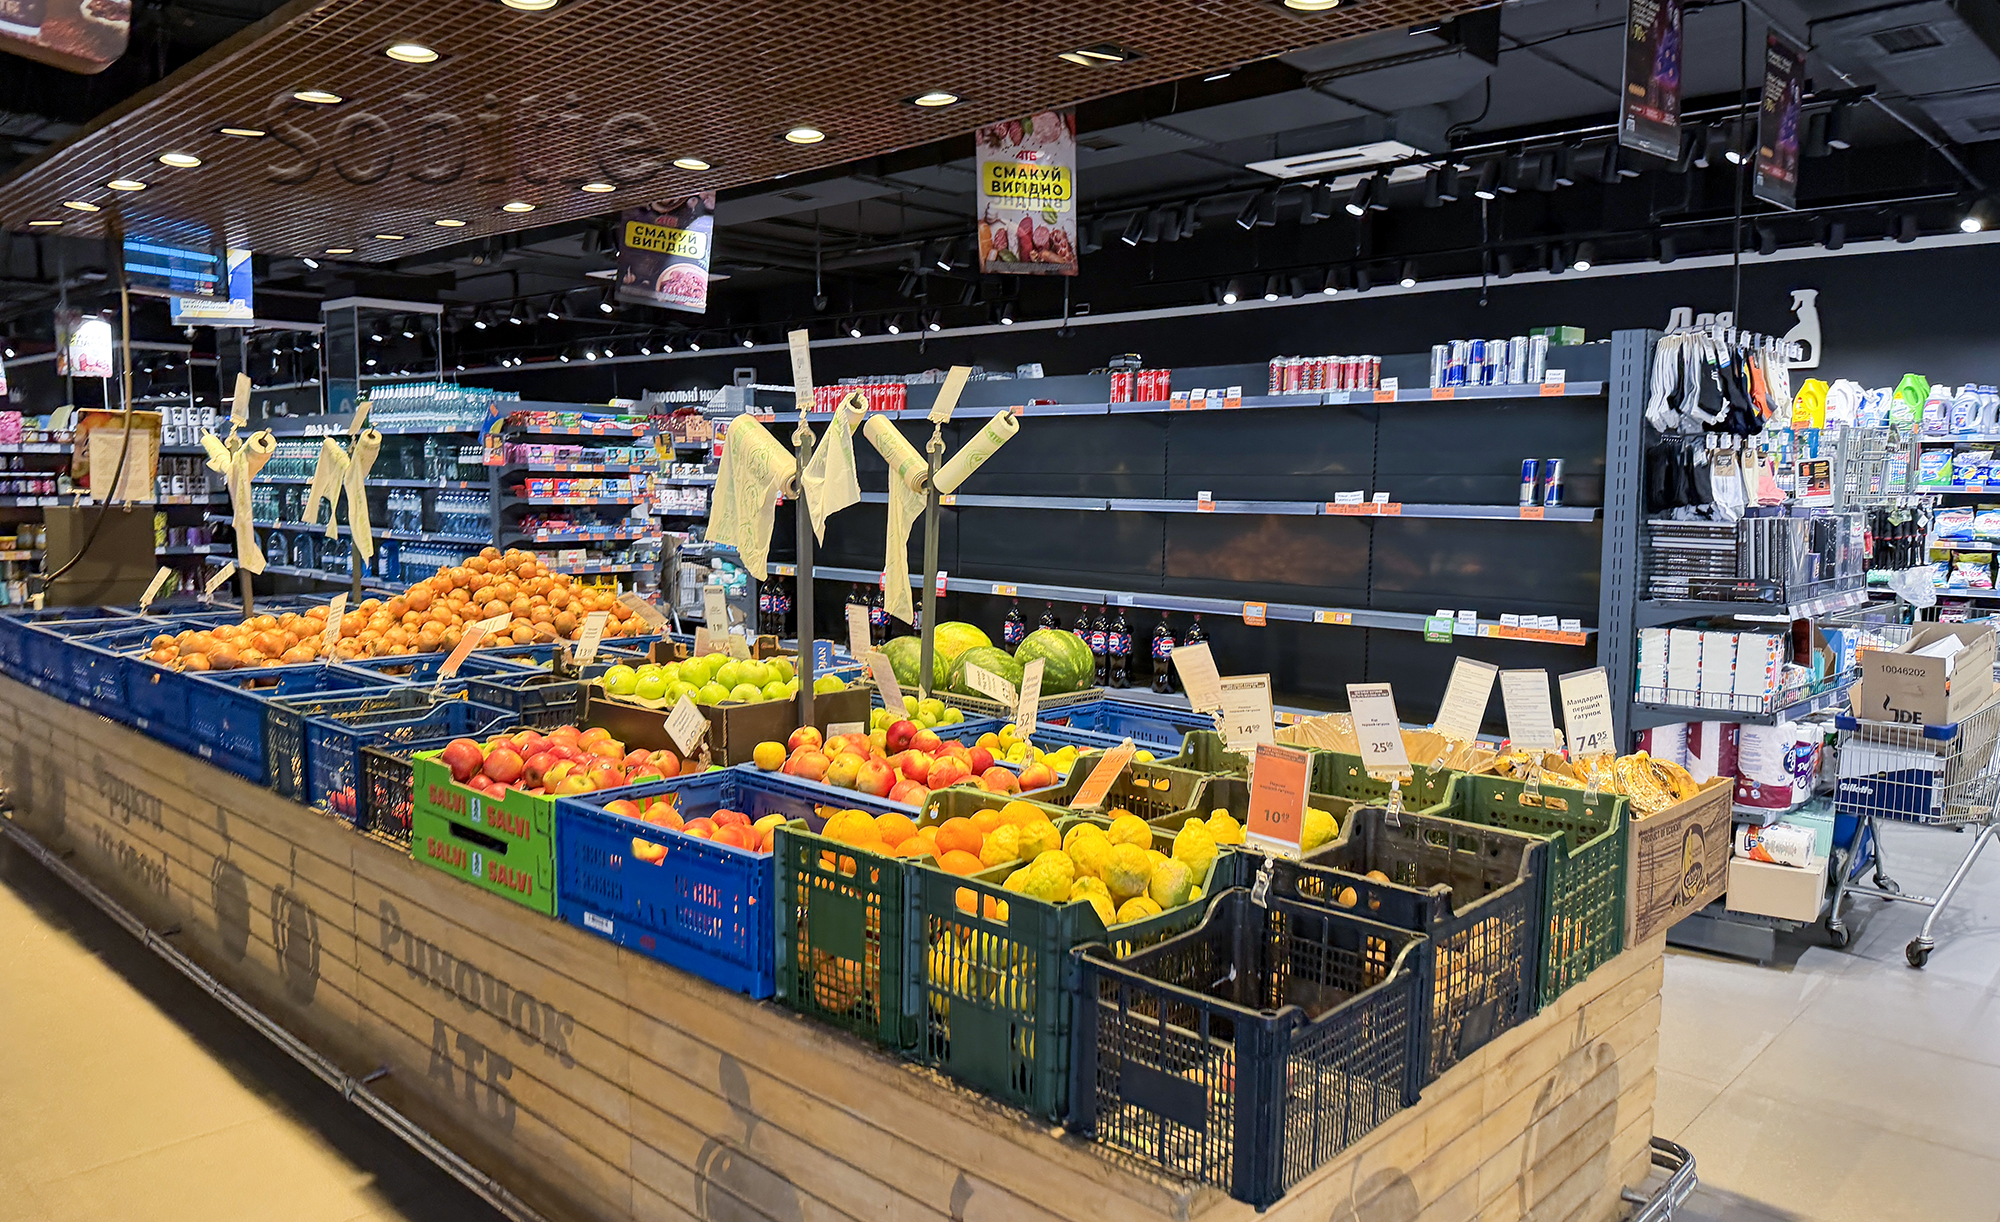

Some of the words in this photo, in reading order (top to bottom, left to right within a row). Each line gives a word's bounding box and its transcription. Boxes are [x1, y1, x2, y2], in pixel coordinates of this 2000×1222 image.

[993, 166, 1061, 183] СМАКУЙ
[991, 180, 1063, 197] ВИГІДНО
[634, 225, 697, 245] СМАКУЙ
[632, 236, 698, 255] ВИГІДНО
[1664, 306, 1734, 335] Для
[1881, 664, 1926, 678] 10046202
[1566, 693, 1603, 706] Мандарин
[1572, 702, 1601, 713] перший
[1888, 707, 1923, 725] JDE
[1838, 782, 1875, 796] Gillette
[428, 784, 467, 816] SALVI
[486, 804, 531, 841] SALVI
[426, 836, 467, 870] SALVI
[488, 860, 533, 896] SALVI
[427, 1017, 518, 1136] АТБ
